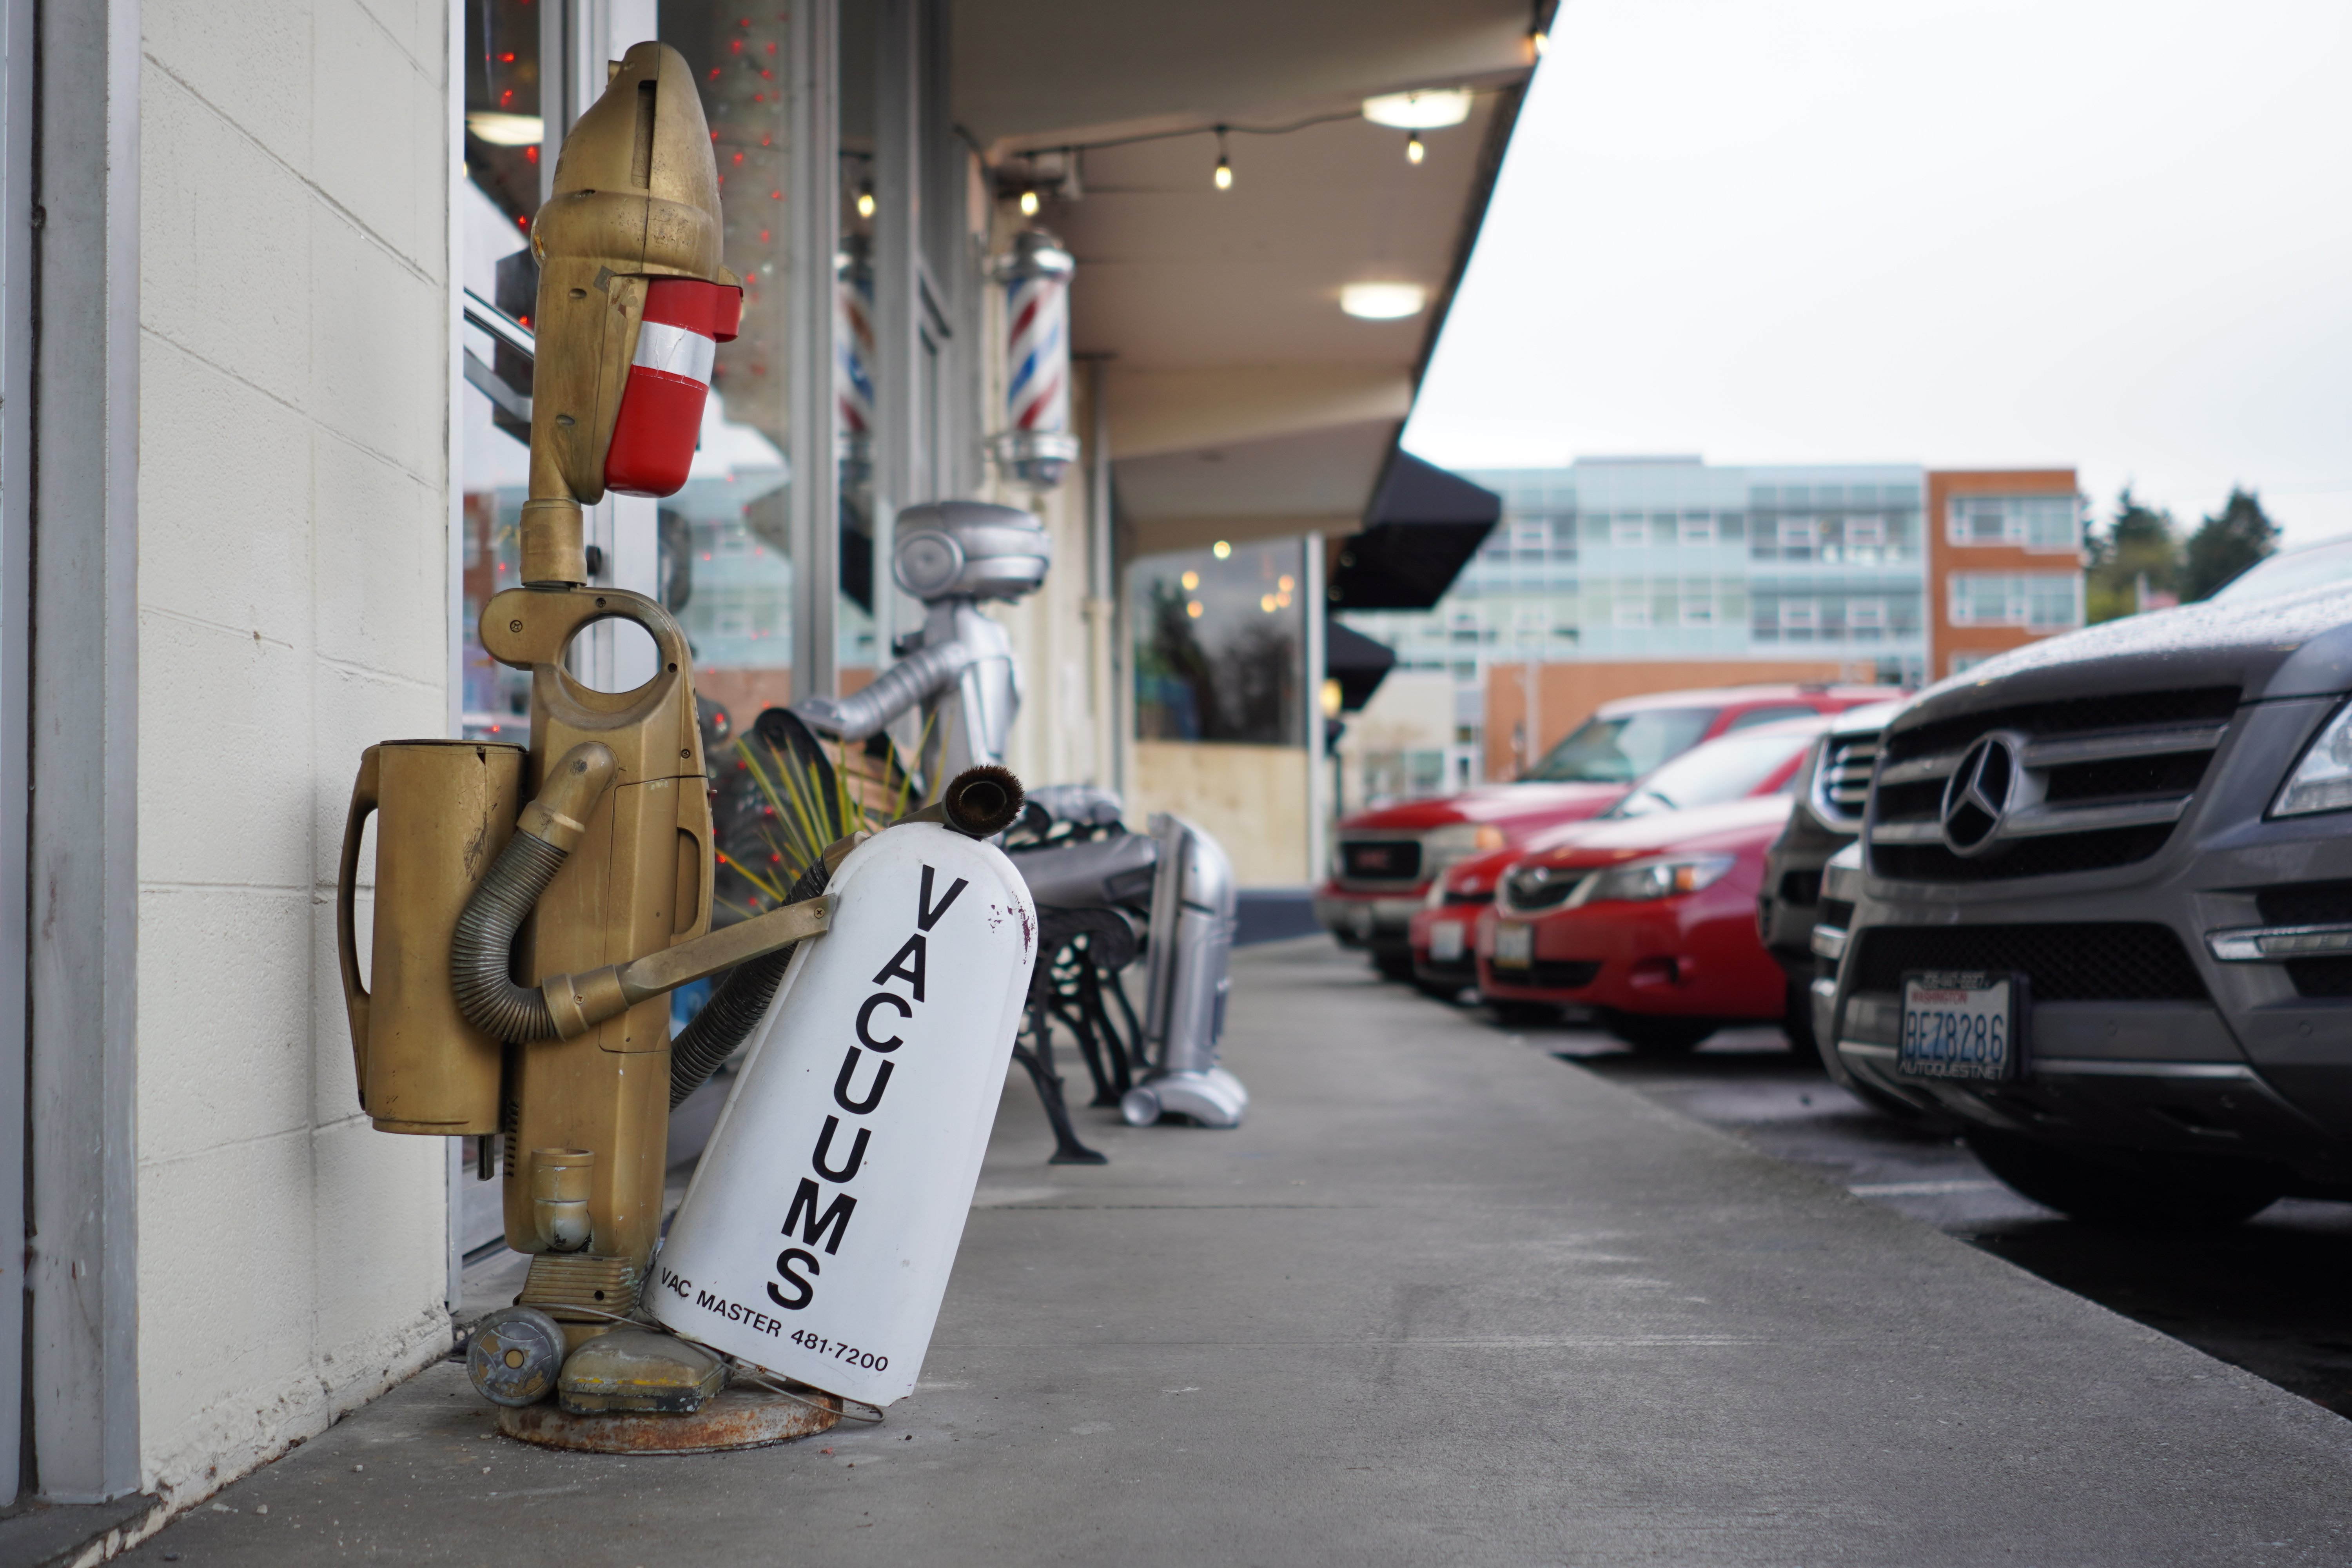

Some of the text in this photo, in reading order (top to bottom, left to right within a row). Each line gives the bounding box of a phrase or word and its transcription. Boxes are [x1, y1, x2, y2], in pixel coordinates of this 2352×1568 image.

[1910, 991, 1968, 1004] WASHINGTON
[1906, 1011, 2004, 1062] BEZ8286
[767, 864, 969, 1310] VACUUMS
[661, 1267, 691, 1298] VAC
[697, 1290, 782, 1338] MASTER
